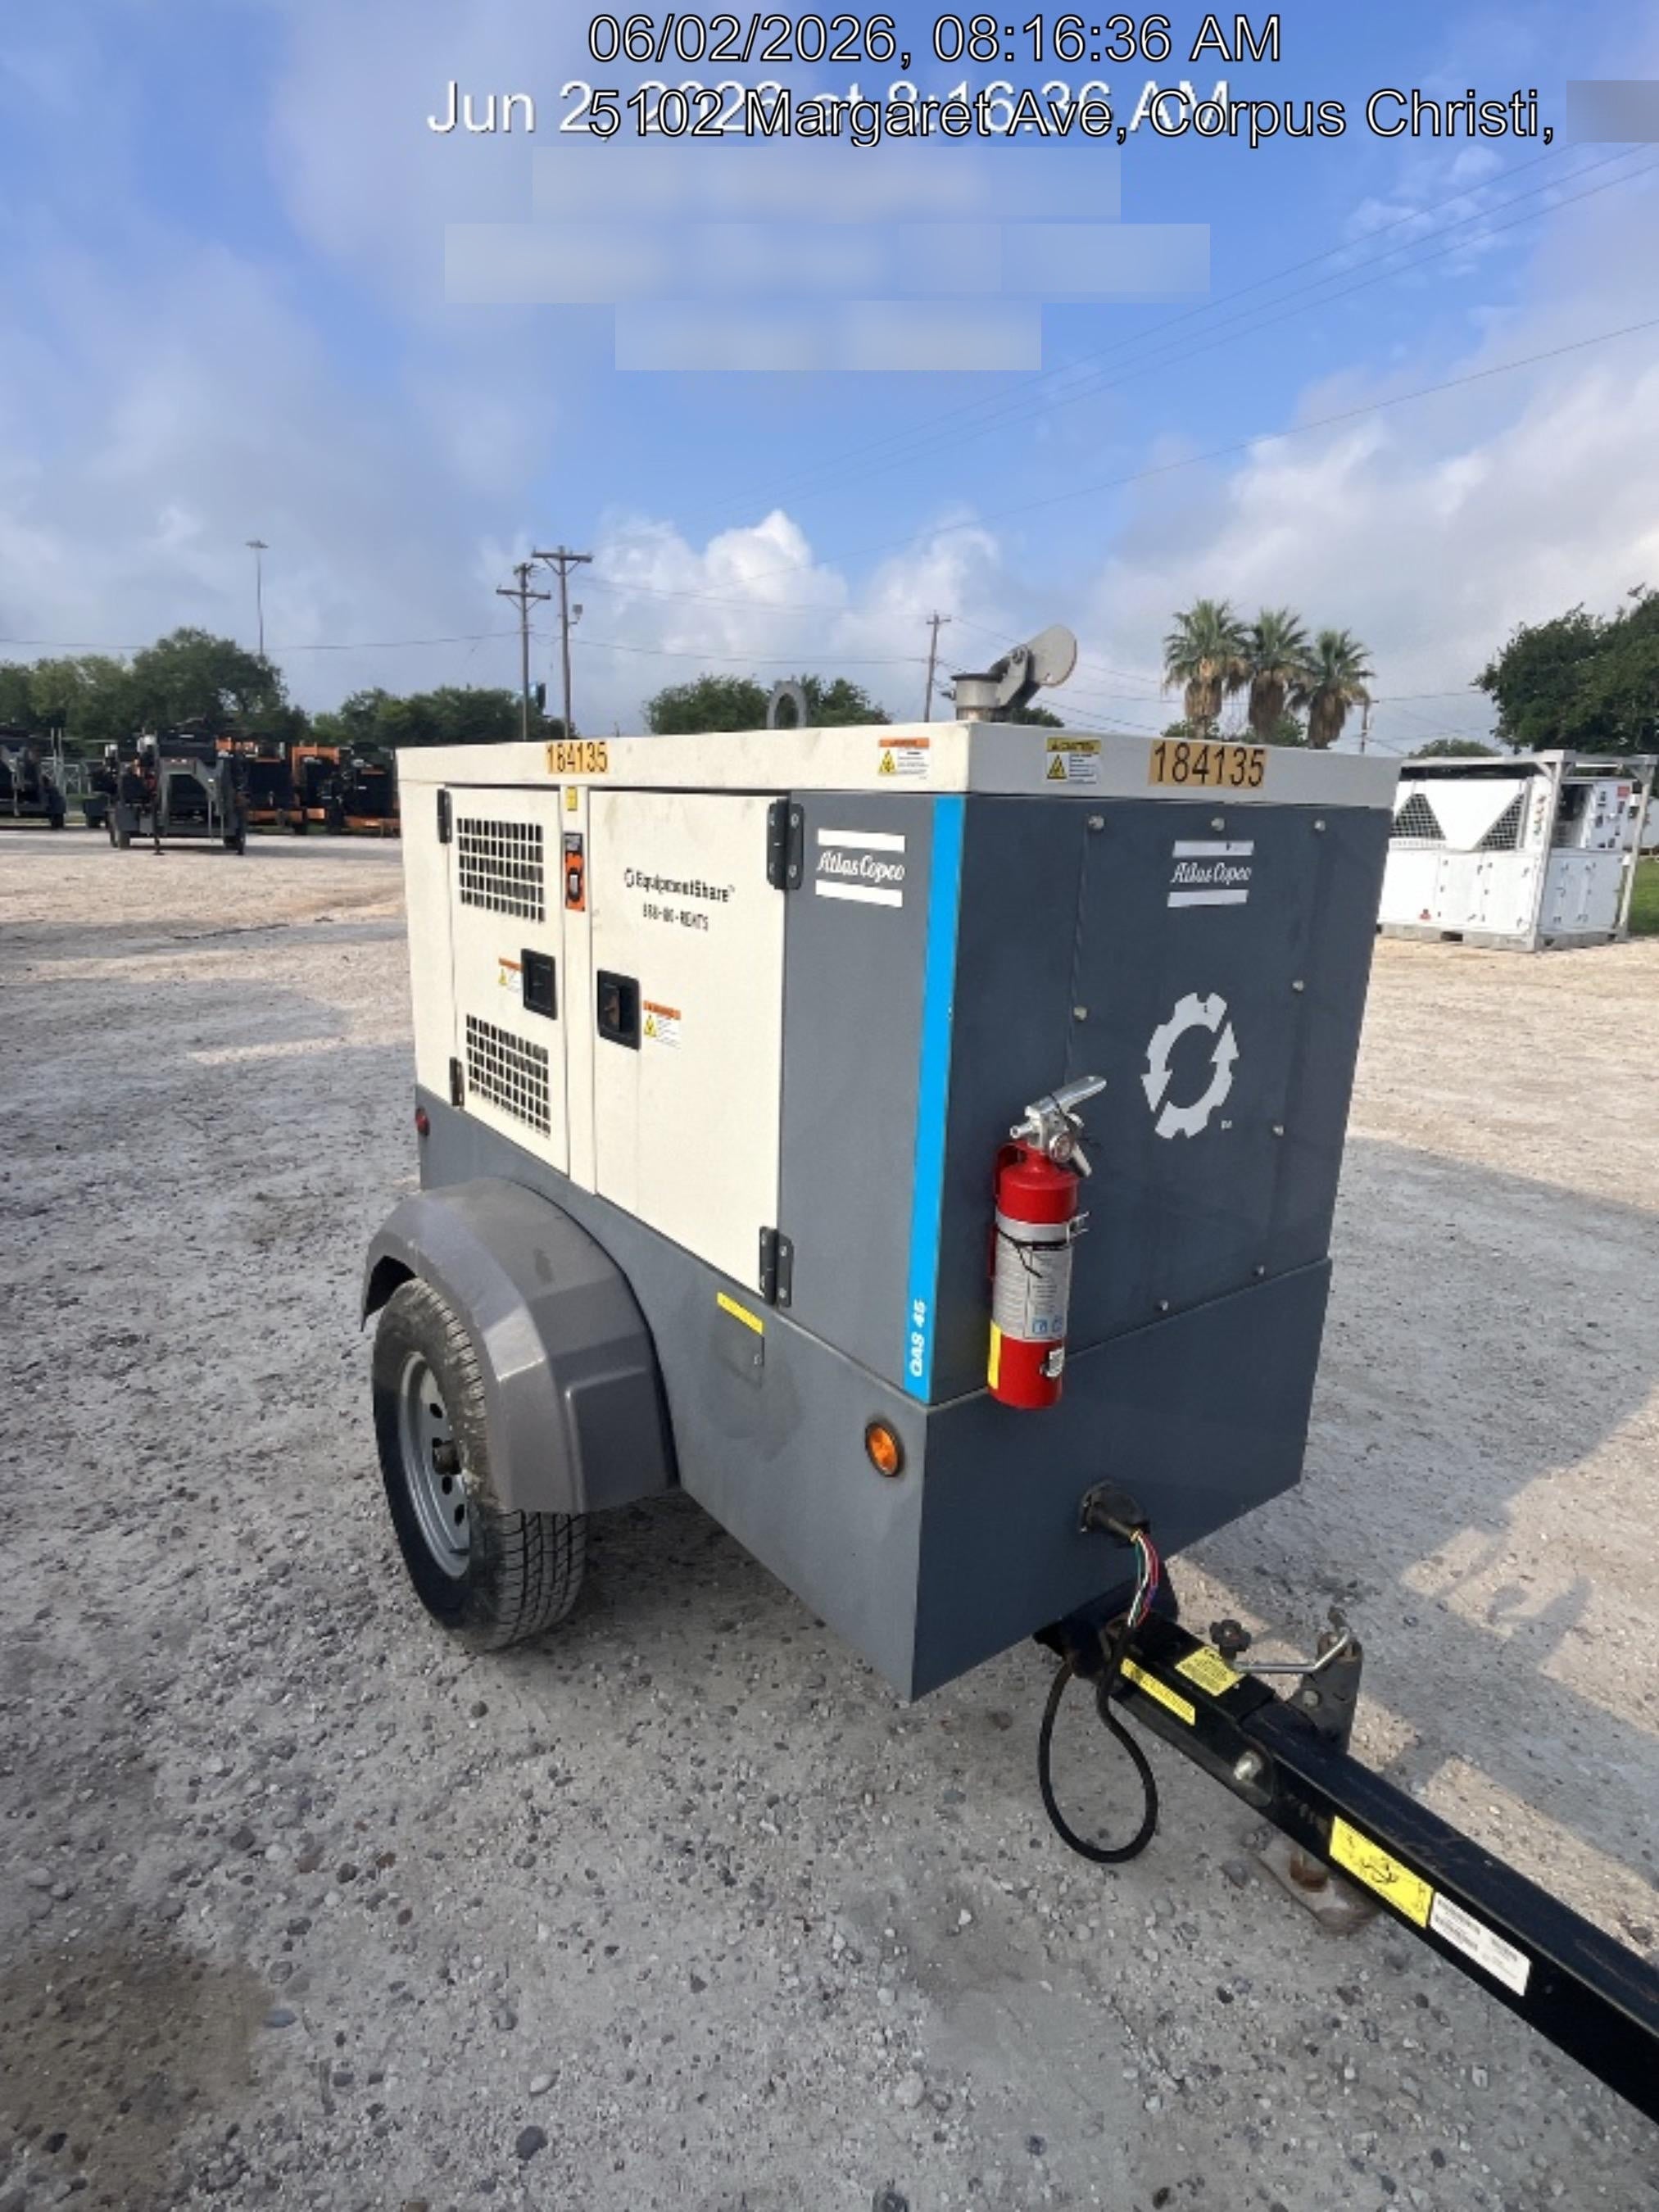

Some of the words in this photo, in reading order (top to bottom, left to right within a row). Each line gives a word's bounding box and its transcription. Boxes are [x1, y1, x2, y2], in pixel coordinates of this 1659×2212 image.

[1154, 741, 1265, 787] 184135
[816, 850, 859, 877] Atlas
[859, 854, 905, 884] Copco
[1169, 861, 1213, 884] Atlas
[1213, 861, 1253, 886] Copco
